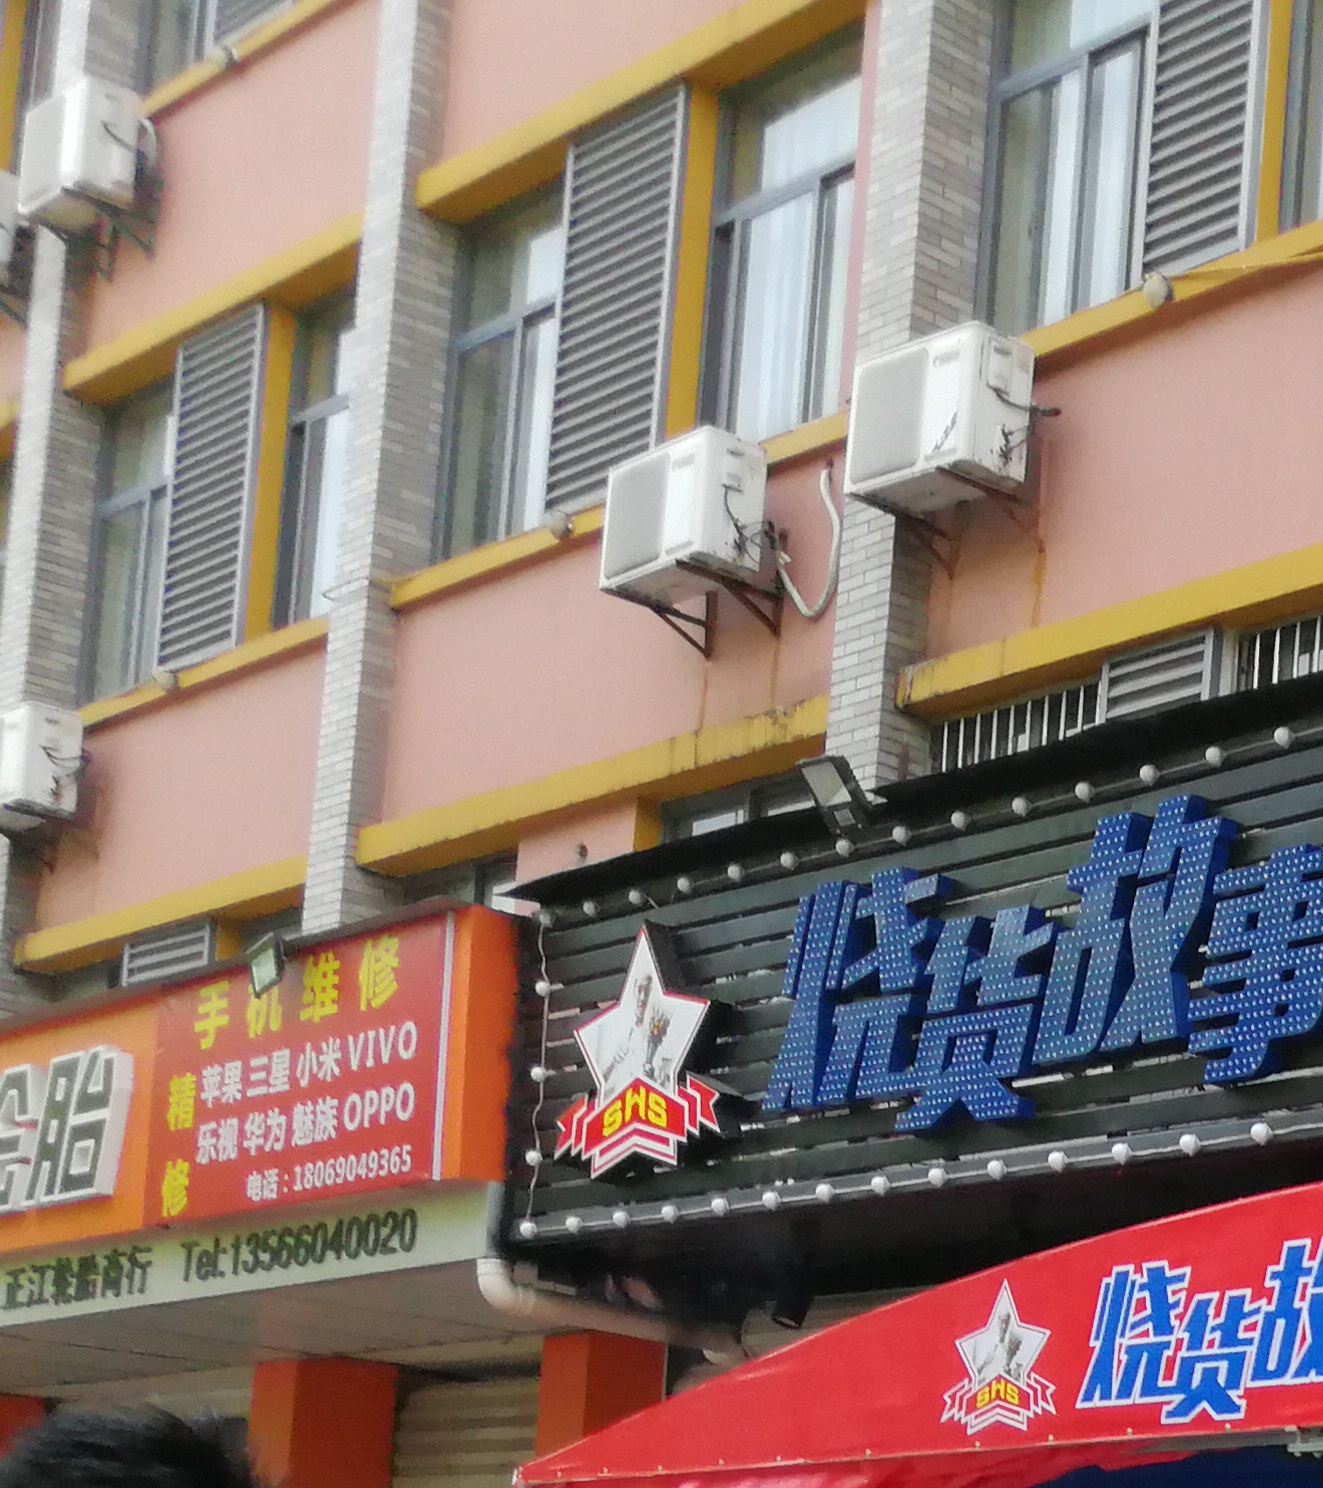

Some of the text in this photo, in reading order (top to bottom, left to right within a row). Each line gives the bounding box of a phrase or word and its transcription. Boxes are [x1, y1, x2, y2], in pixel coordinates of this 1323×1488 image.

[194, 935, 399, 1050] 手机维修
[201, 1021, 418, 1108] 苹果 三星 小米 VIVO
[195, 1082, 415, 1165] 乐视 华为 魅族 OPPO
